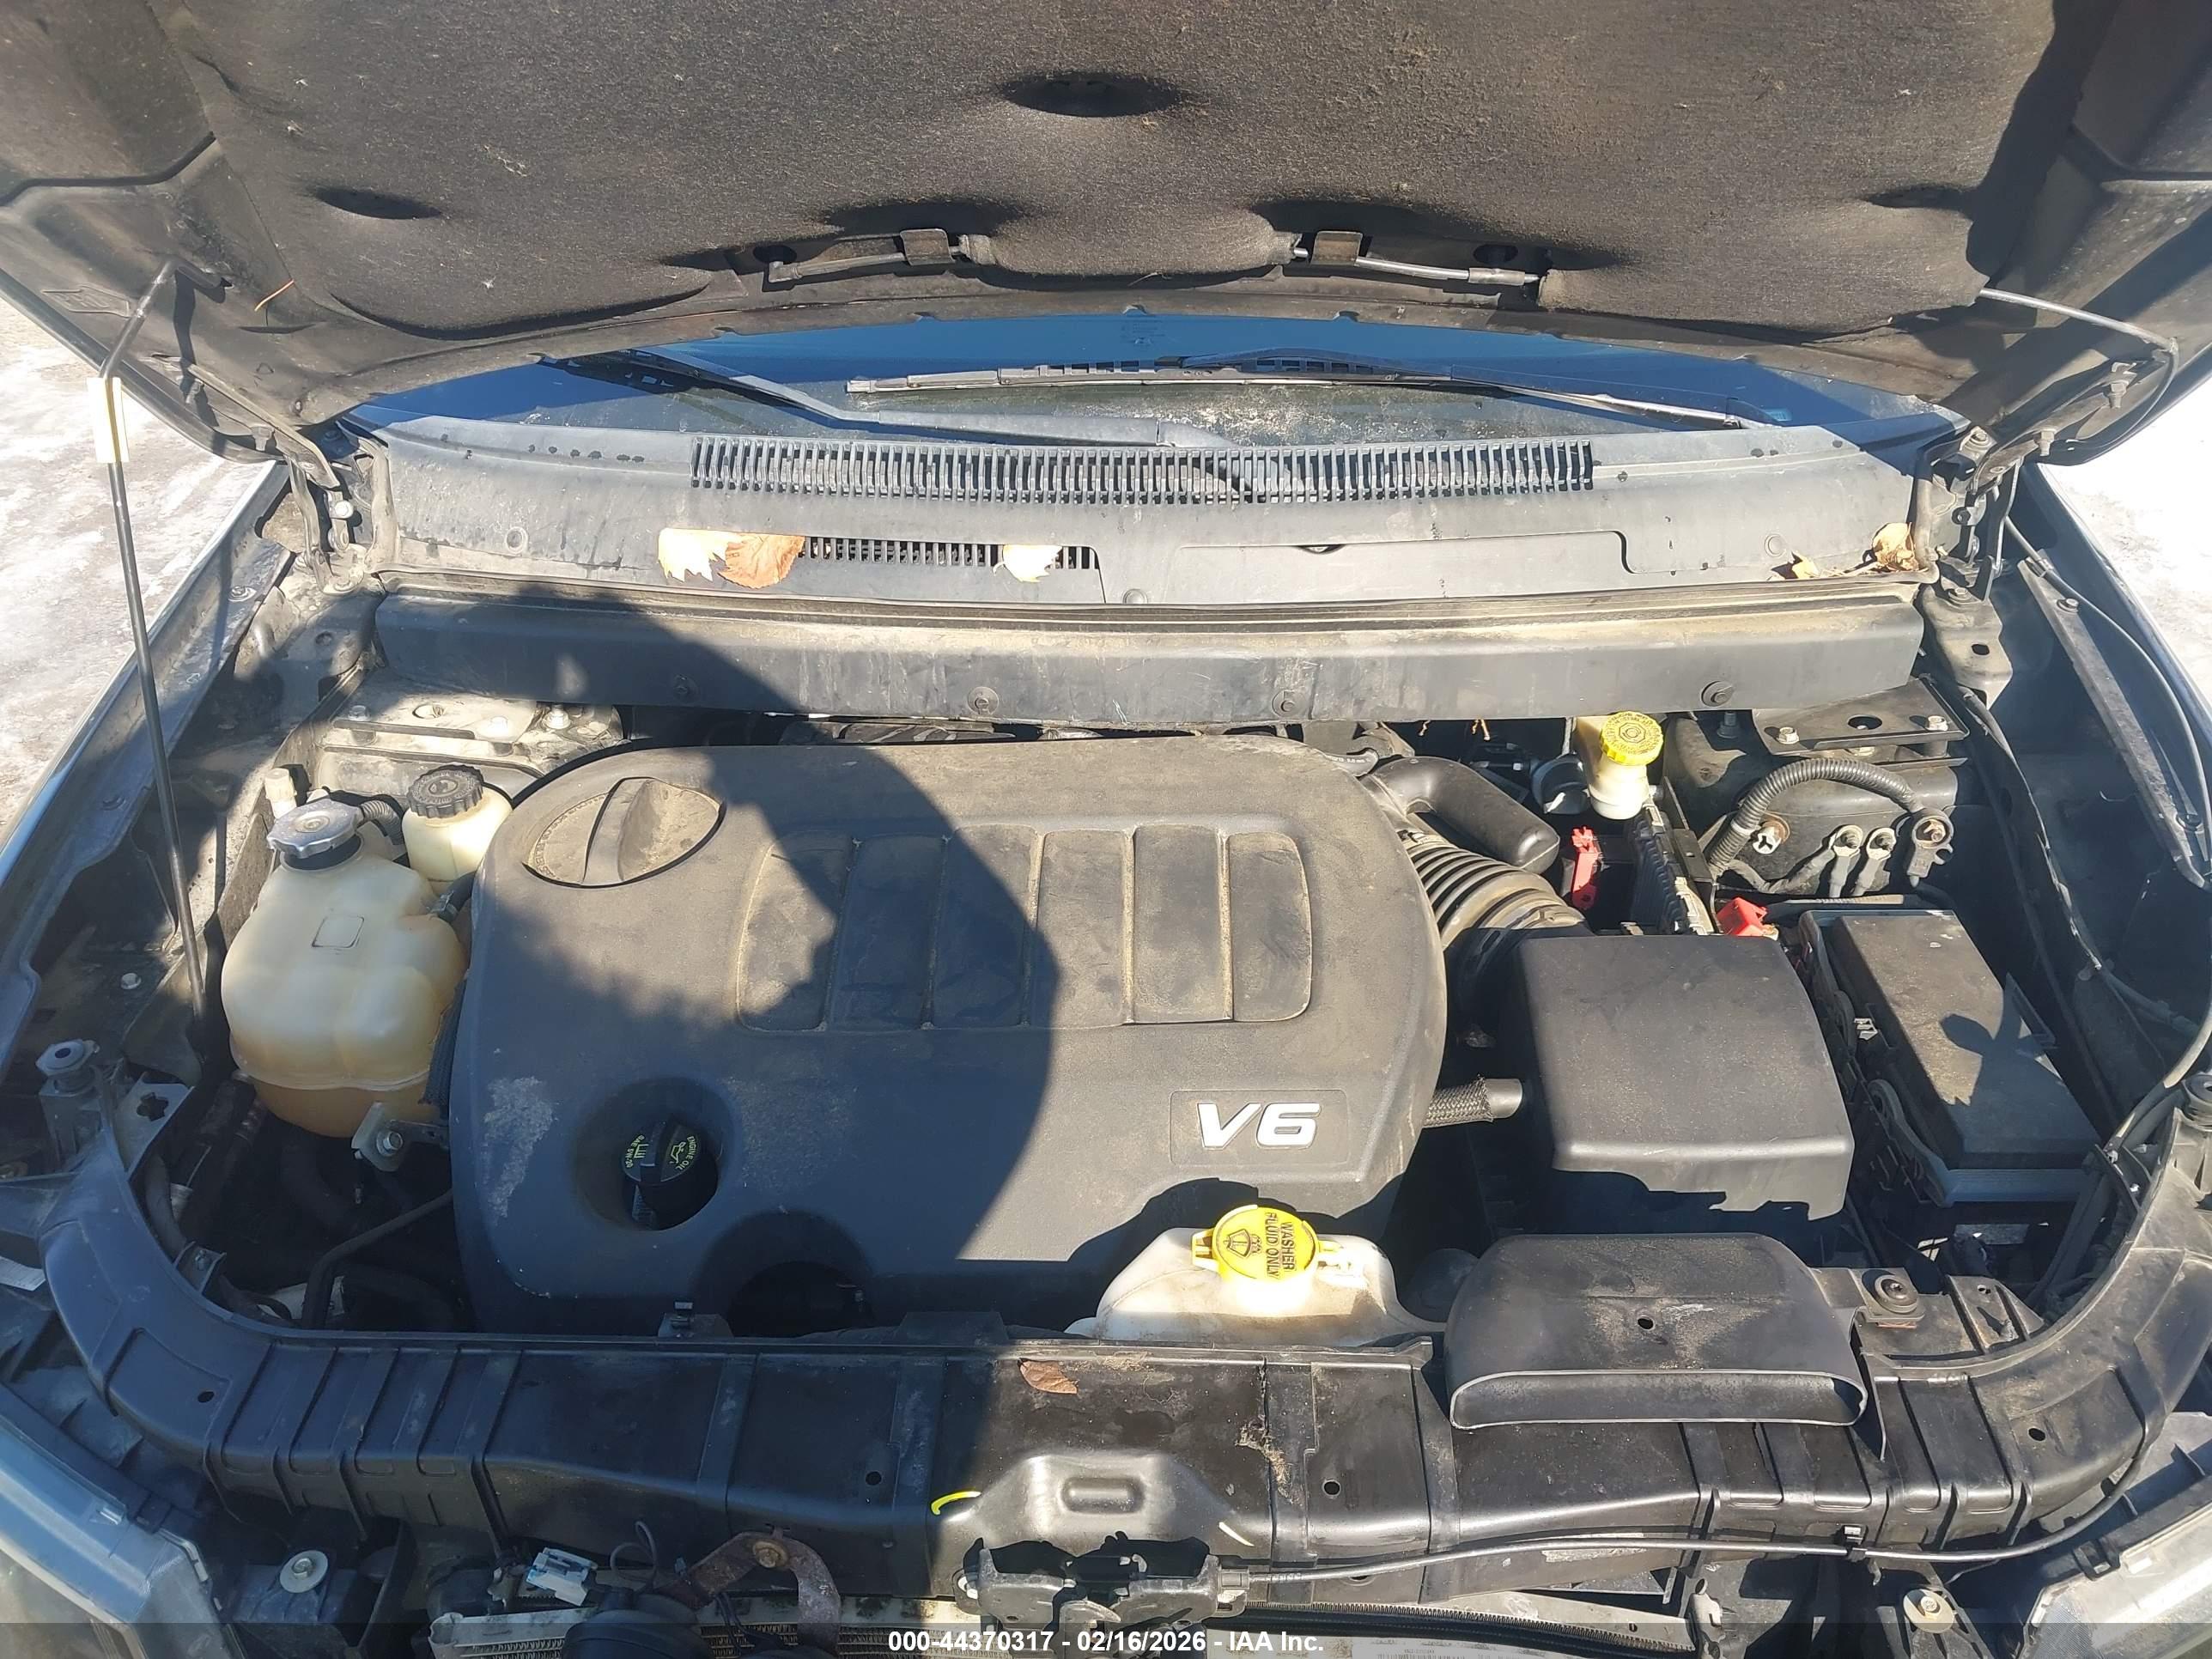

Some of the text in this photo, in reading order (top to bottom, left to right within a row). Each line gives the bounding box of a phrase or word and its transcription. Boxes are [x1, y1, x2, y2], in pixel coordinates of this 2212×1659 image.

[1197, 1103, 1322, 1150] V6
[624, 1148, 635, 1168] 5W-20
[675, 1135, 697, 1170] ENGINE OIL
[1264, 1212, 1281, 1279] FLUID ONLY
[1280, 1221, 1296, 1272] WASHER
